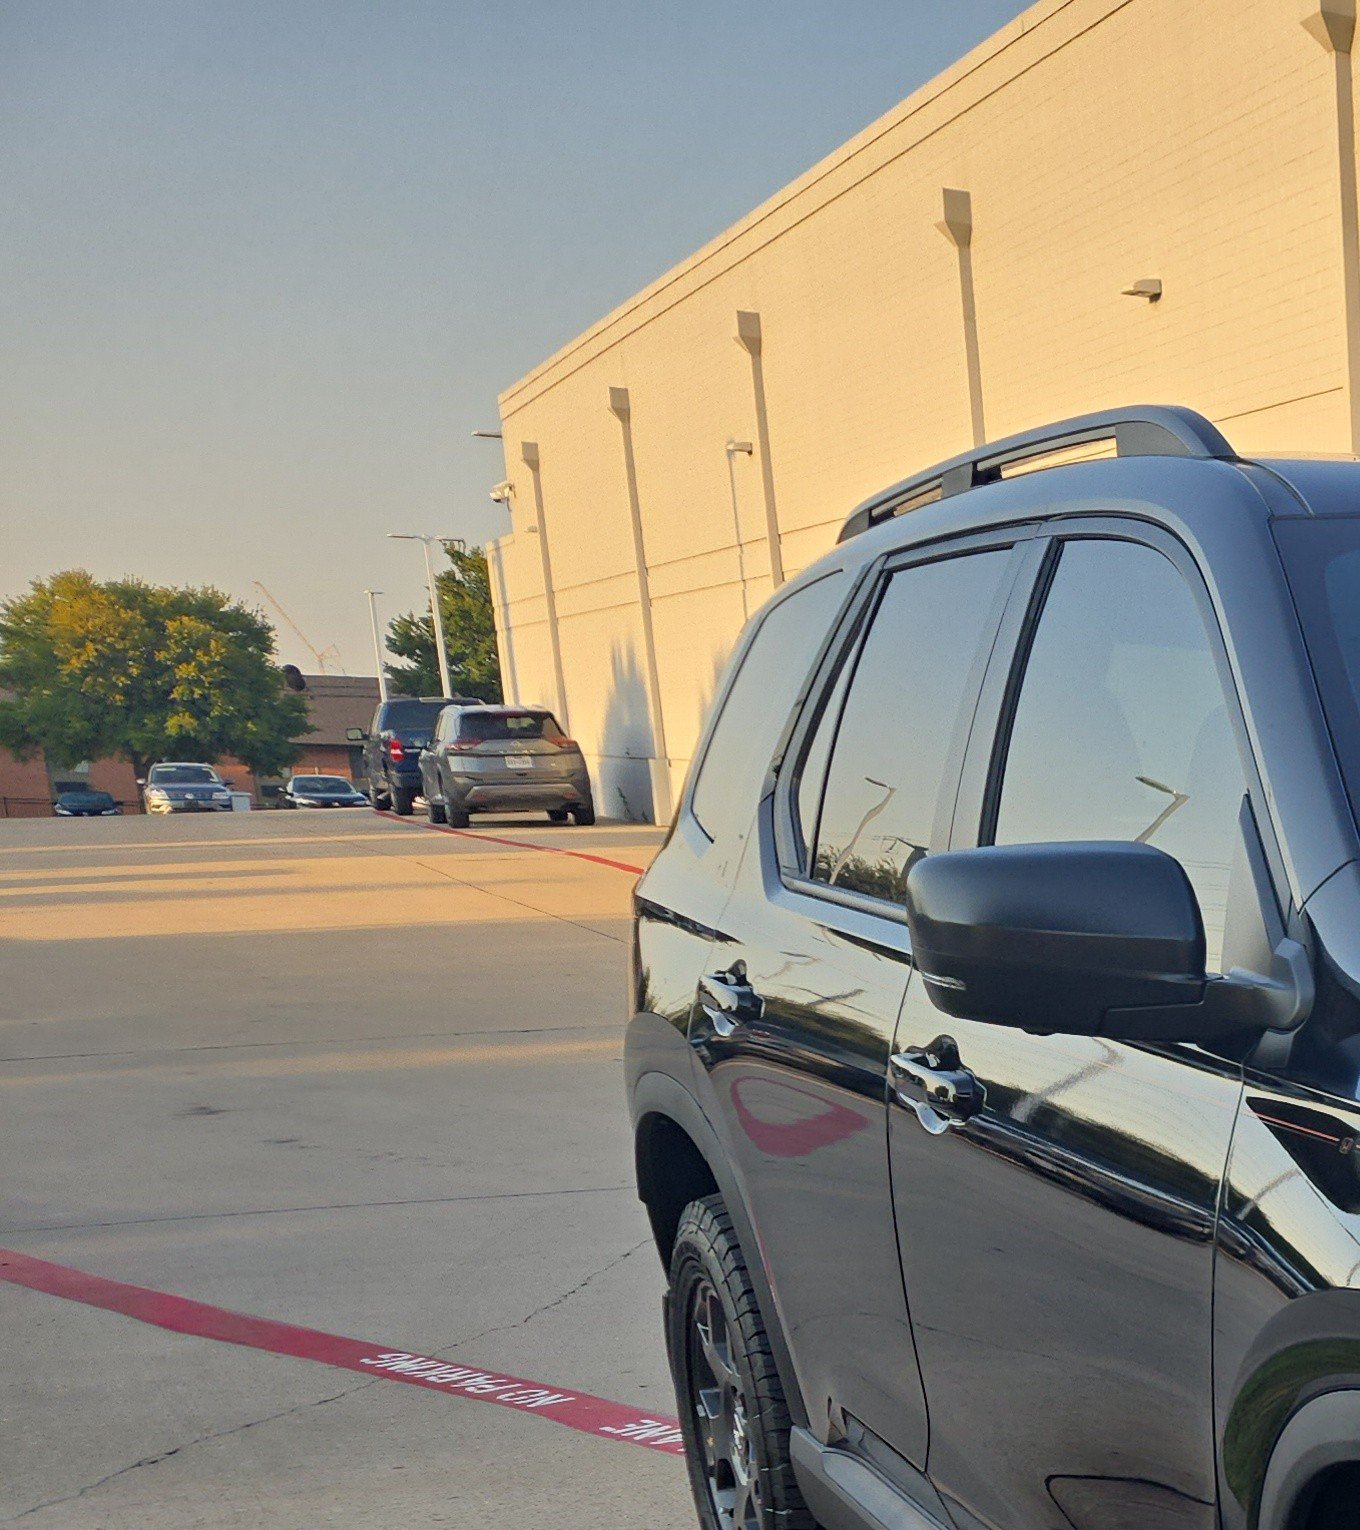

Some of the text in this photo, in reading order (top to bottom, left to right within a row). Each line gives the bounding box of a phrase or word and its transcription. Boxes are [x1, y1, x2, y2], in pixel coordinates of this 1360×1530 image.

[360, 1353, 684, 1451] ANE NO PARKING
